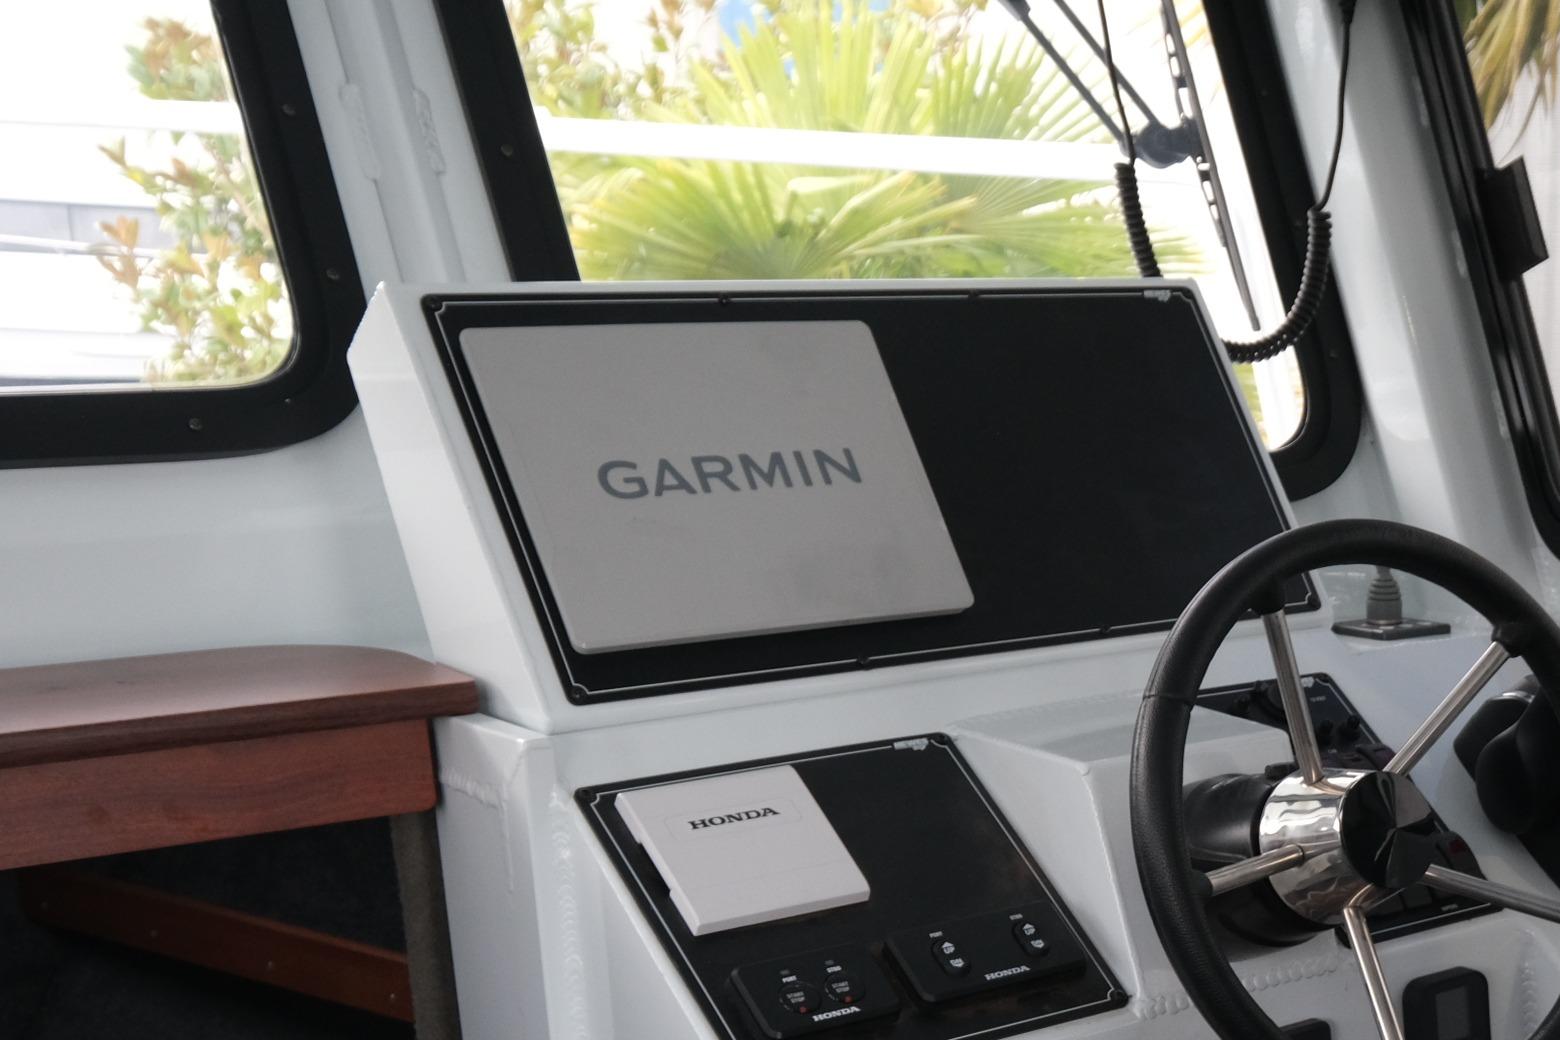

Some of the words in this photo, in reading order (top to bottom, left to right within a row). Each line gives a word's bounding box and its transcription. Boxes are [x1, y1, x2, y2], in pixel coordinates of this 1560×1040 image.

[597, 447, 862, 499] GARMIN
[688, 807, 780, 830] HONDA
[942, 945, 956, 955] UP
[983, 965, 1031, 981] HONDA
[812, 1005, 861, 1022] HONDA
